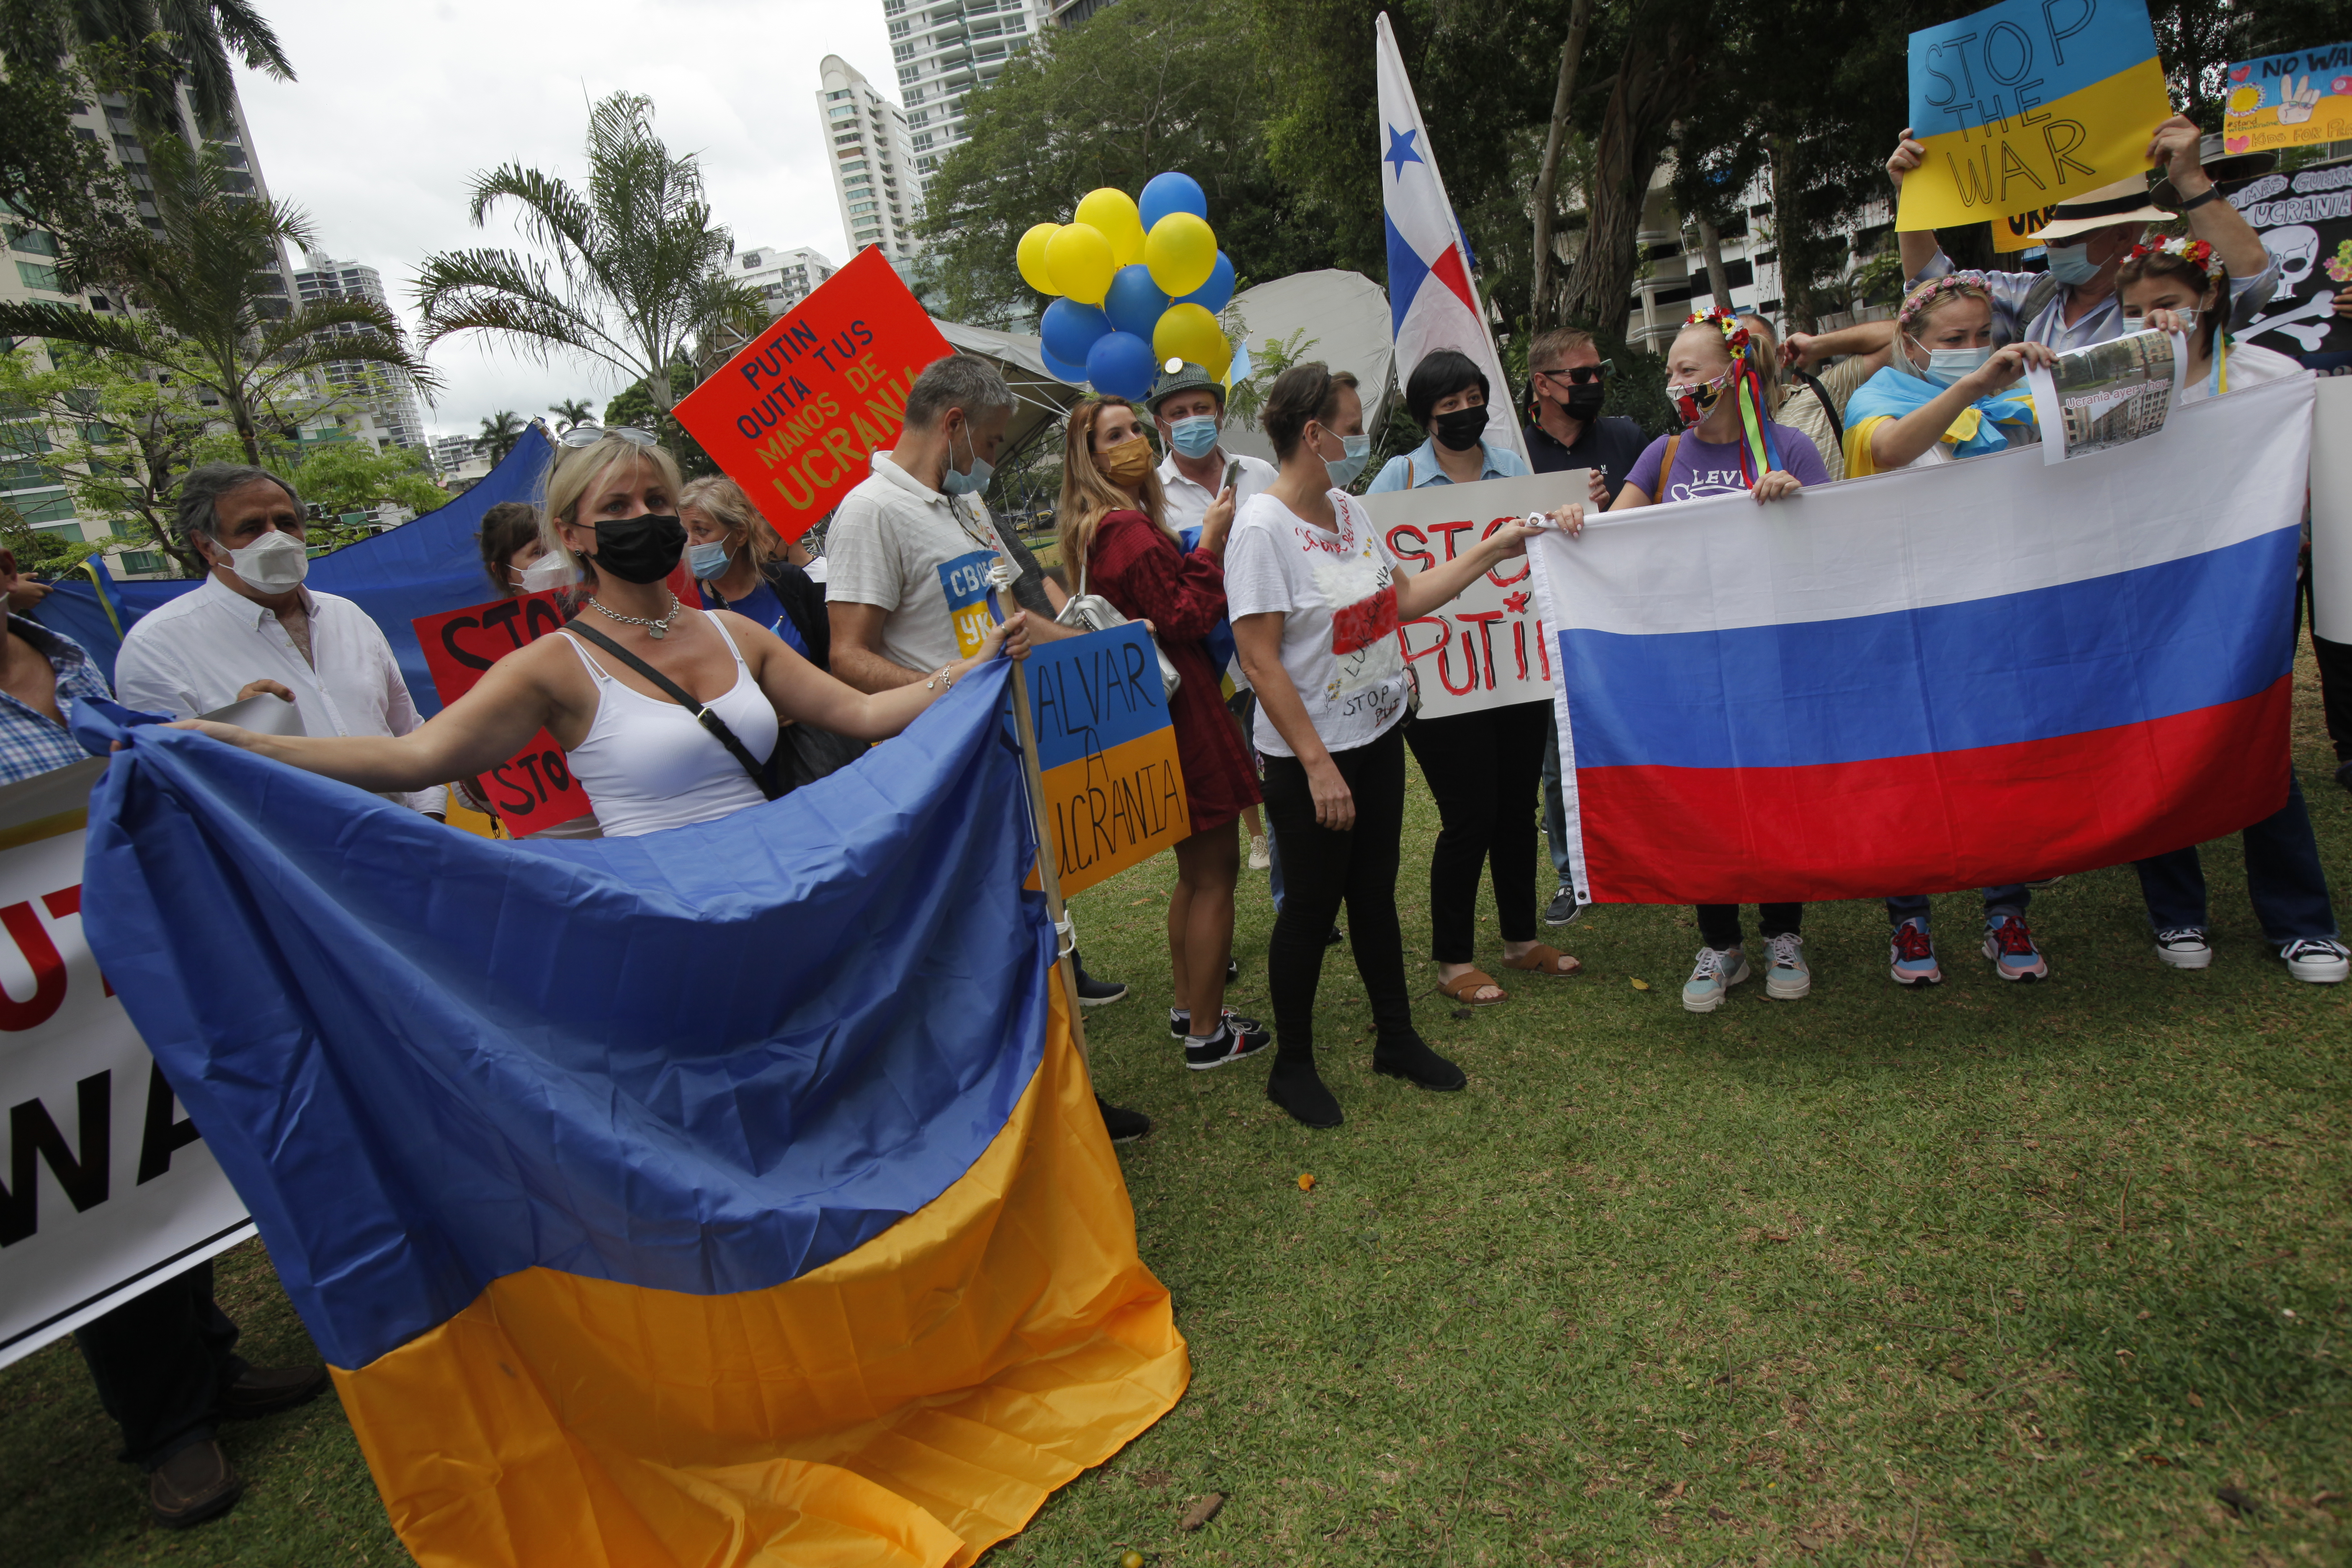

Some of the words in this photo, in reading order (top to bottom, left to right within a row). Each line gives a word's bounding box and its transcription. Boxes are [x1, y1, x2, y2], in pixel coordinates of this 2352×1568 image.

[1925, 0, 2096, 106] STOP
[2262, 57, 2299, 79] NO
[2306, 46, 2352, 72] WA
[1943, 78, 2051, 142] THE
[2227, 117, 2257, 128] #stand
[2293, 127, 2322, 142] FOR
[1947, 119, 2096, 207] WAR
[2254, 192, 2352, 225] UCRANIA
[736, 374, 812, 440] QUITA
[812, 320, 874, 373] TUS
[740, 319, 818, 391] PUTIN
[755, 392, 840, 469] MANOS
[844, 351, 887, 395] DE
[2066, 391, 2110, 409] Ucrania
[2113, 386, 2137, 399] ayer
[2137, 383, 2147, 395] y
[2148, 378, 2169, 392] hoy
[959, 611, 995, 645] УК
[1005, 642, 1156, 743] ALVAR
[1343, 685, 1390, 716] STOP
[492, 747, 583, 815] STO
[1086, 727, 1109, 791] A
